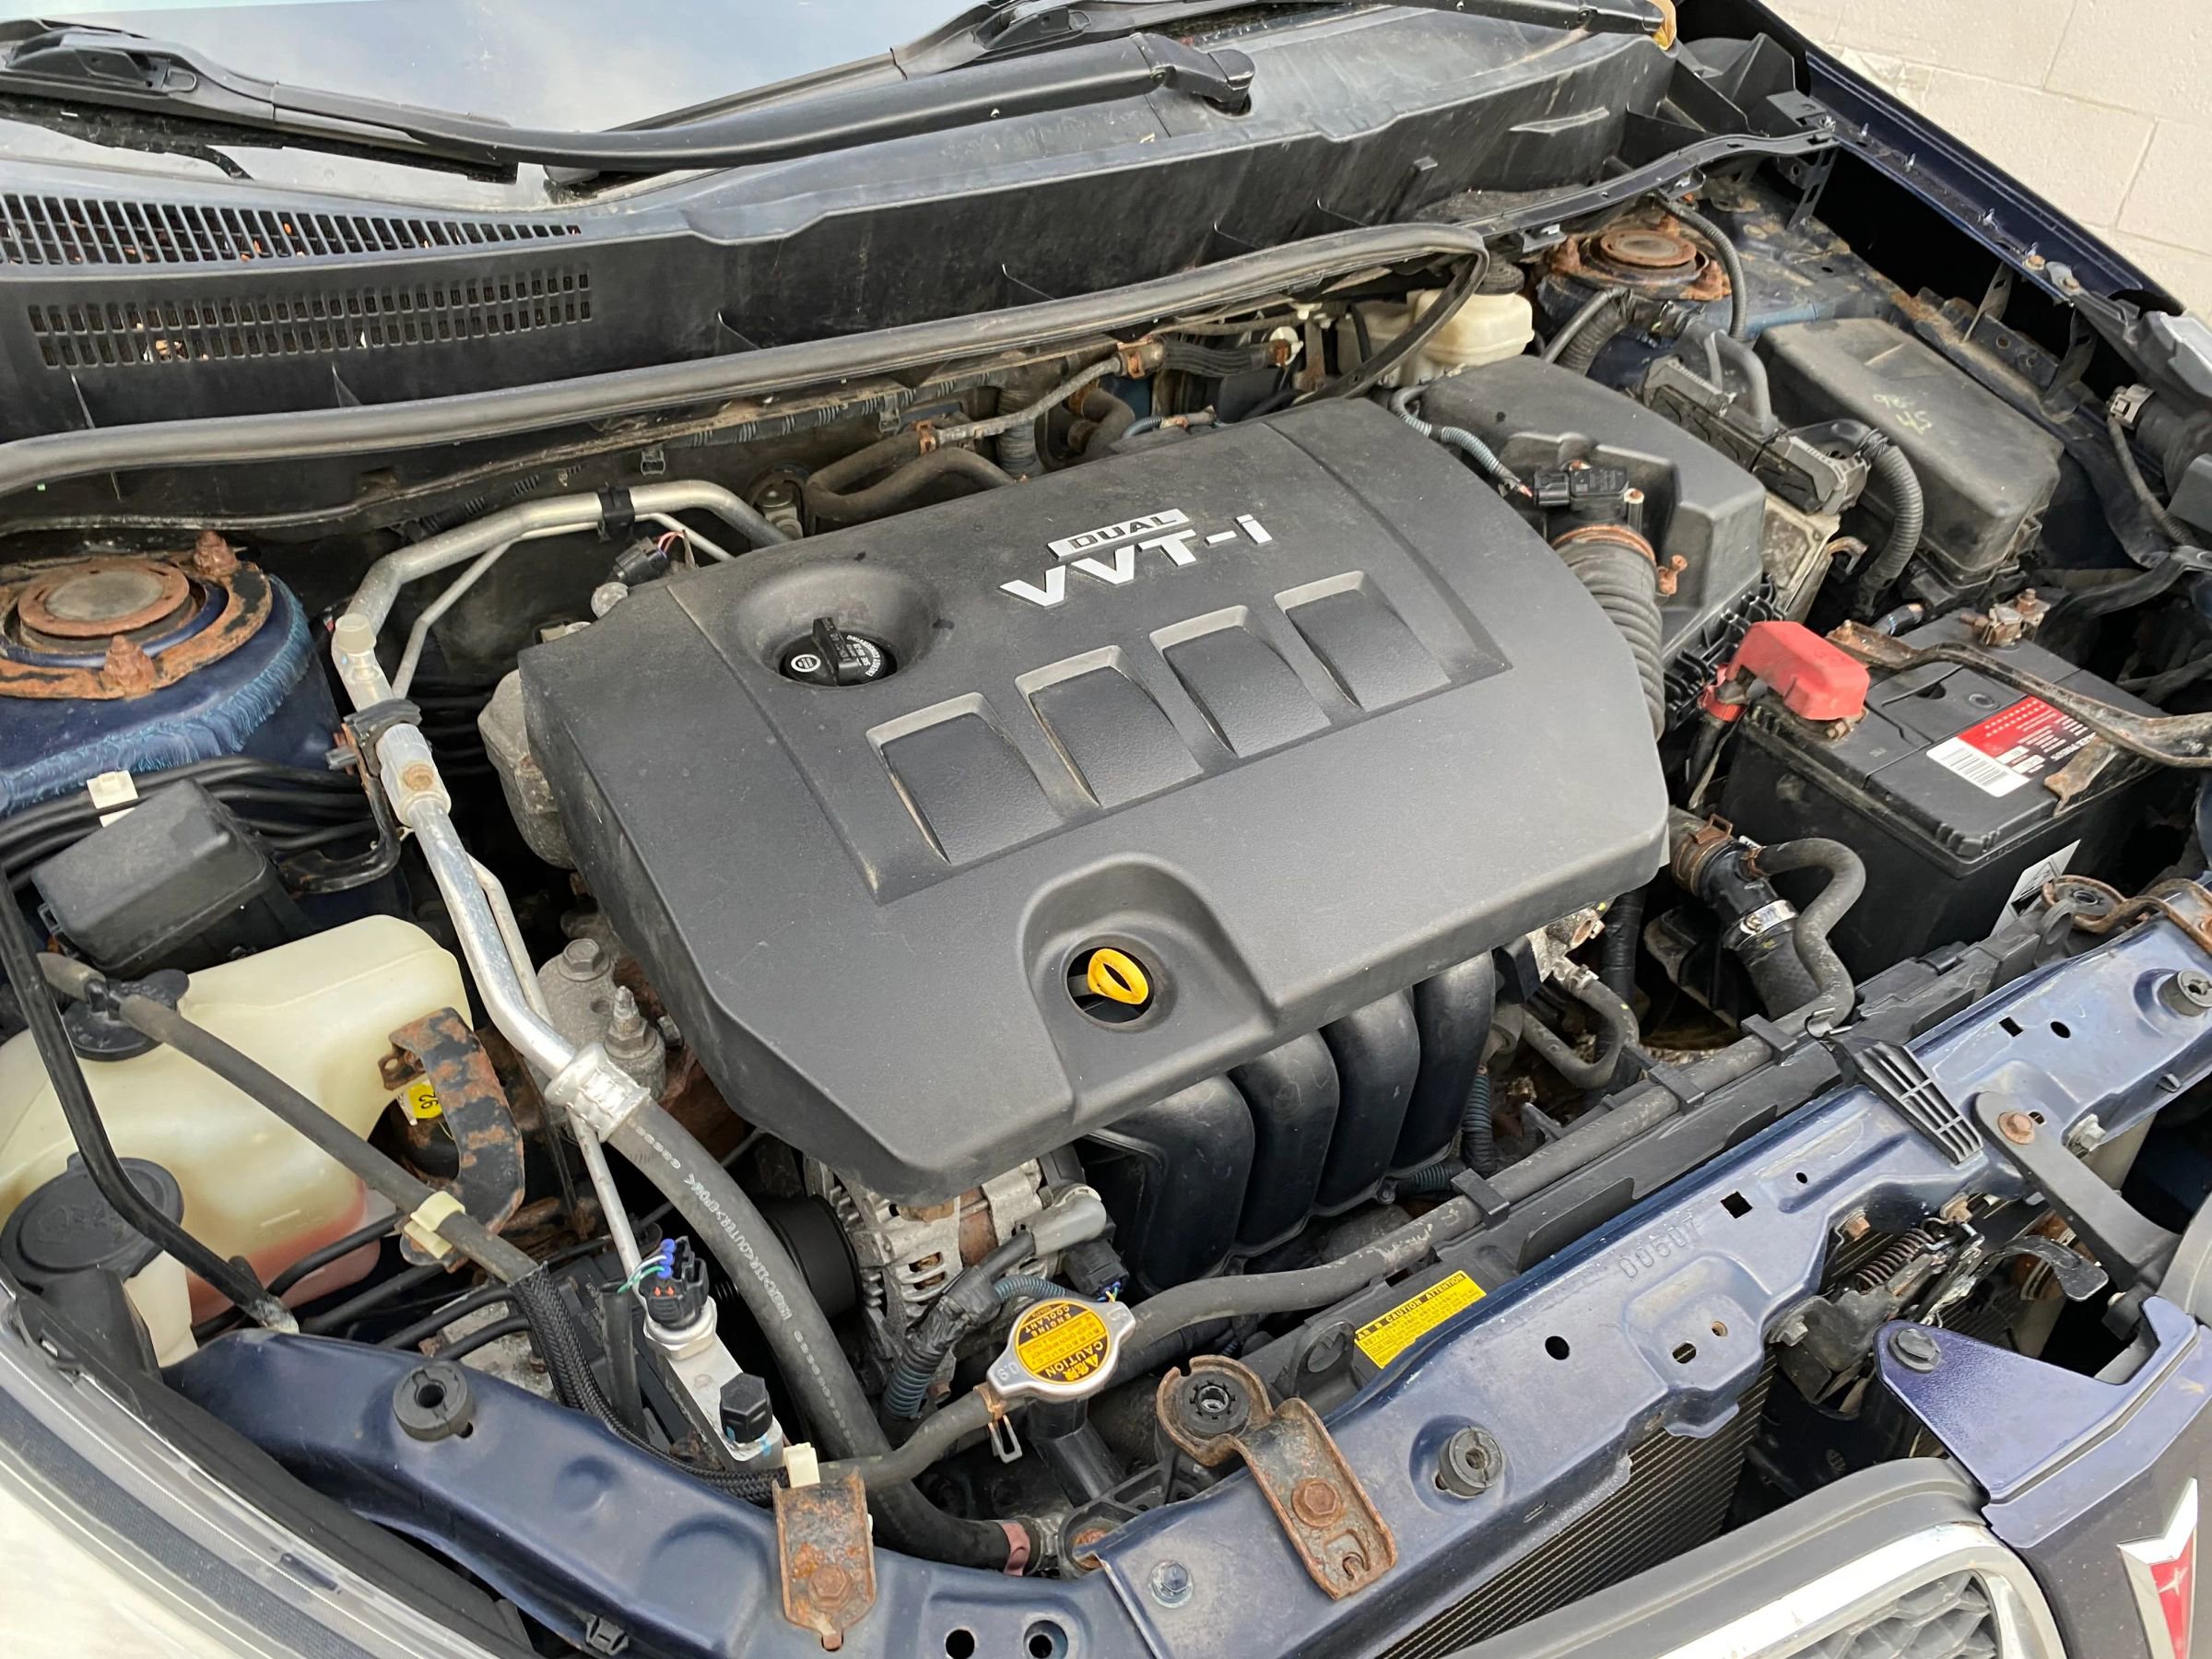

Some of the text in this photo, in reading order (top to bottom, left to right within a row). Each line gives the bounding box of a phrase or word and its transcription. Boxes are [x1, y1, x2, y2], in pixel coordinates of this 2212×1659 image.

[1069, 516, 1177, 549] DUAL
[1385, 1299, 1422, 1323] CAUTION
[1426, 1274, 1465, 1300] ATTENTION
[1023, 1305, 1069, 1333] COOLANT
[1030, 1312, 1071, 1337] ENGINE
[1044, 1339, 1103, 1378] CAUTION
